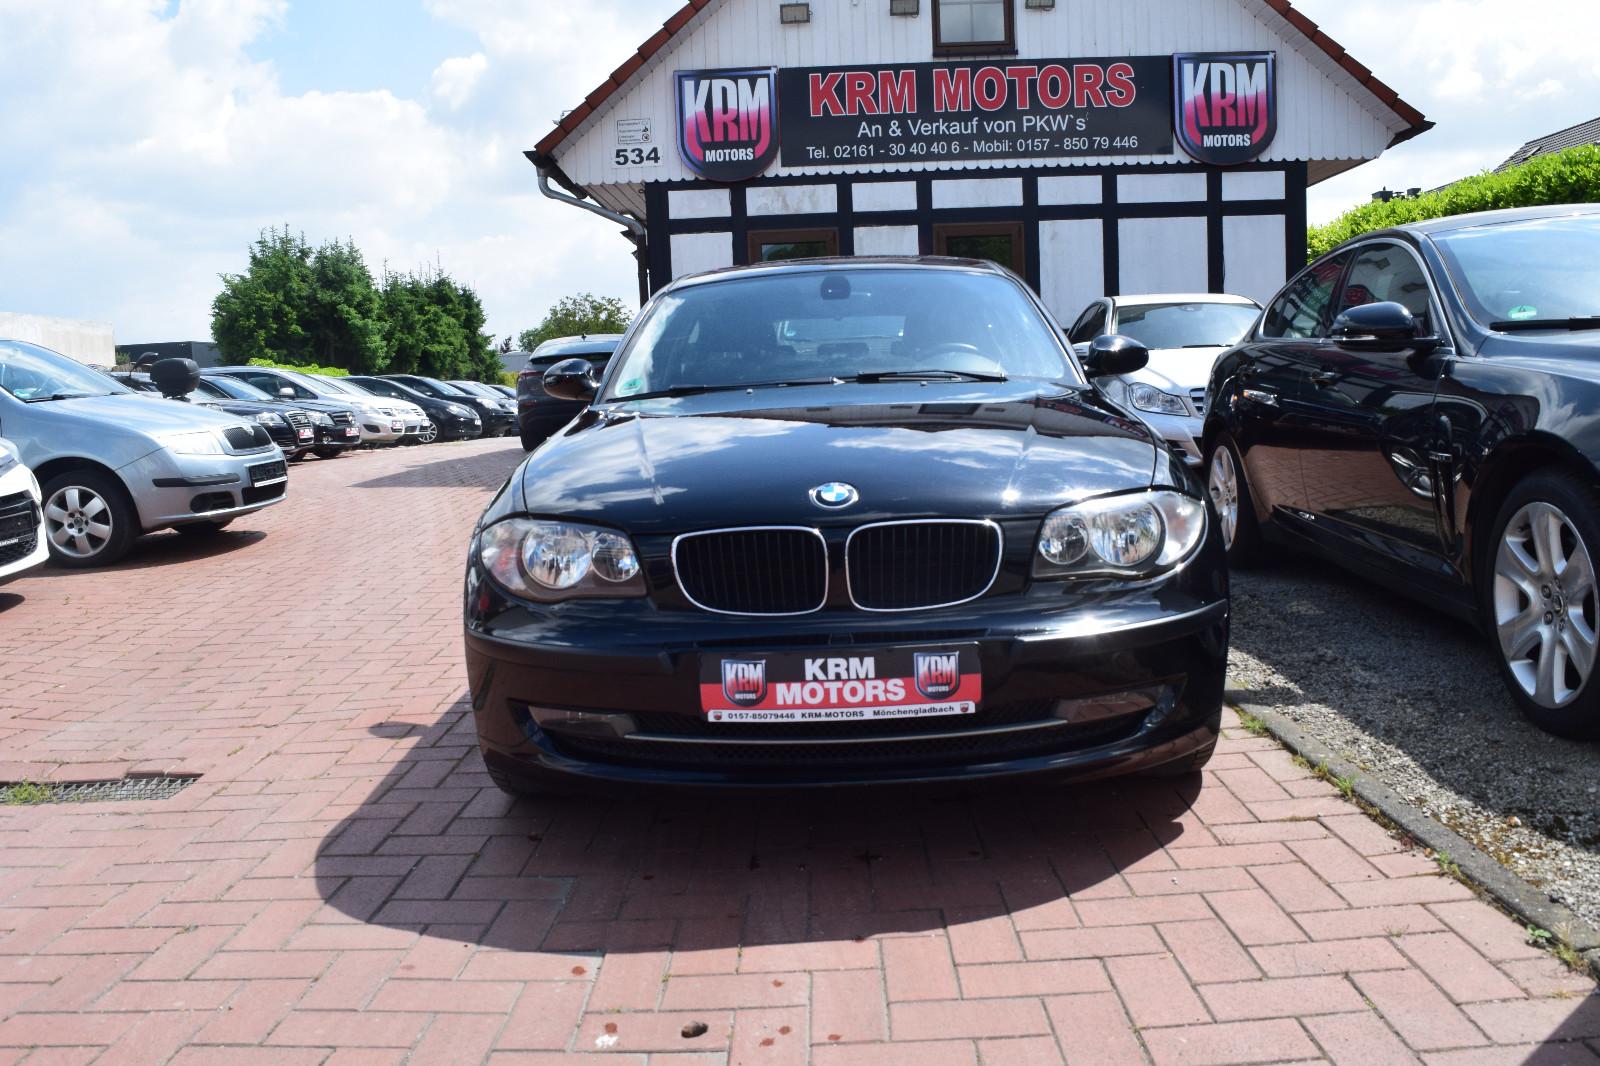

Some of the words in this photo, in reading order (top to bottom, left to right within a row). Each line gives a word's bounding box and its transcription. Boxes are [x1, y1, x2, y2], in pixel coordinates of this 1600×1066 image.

[809, 69, 917, 117] KRM
[933, 62, 1137, 112] MOTORS
[1183, 62, 1267, 147] KRM
[684, 77, 770, 161] KRM
[857, 121, 882, 138] An
[888, 120, 902, 137] &
[907, 117, 979, 137] Verkauf
[983, 120, 1016, 134] von
[806, 145, 830, 159] Tel.
[833, 144, 874, 158] 02161
[888, 143, 906, 156] 30
[909, 142, 926, 155] 40
[930, 141, 947, 154] 40
[951, 141, 960, 154] 6
[973, 139, 1013, 153] Mobil:
[1017, 138, 1050, 152] 0157
[1063, 137, 1089, 150] 850
[1092, 136, 1109, 150] 79
[1112, 135, 1138, 149] 446
[1203, 133, 1251, 148] MOTORS
[615, 146, 660, 165] 534
[705, 147, 754, 162] MOTORS
[725, 663, 763, 697] KRM
[804, 656, 876, 681] KRM
[918, 655, 956, 690] KRM
[775, 678, 906, 705] MOTORS
[728, 712, 795, 720] 0157-85079446
[801, 710, 865, 719] KRM-MOTORS
